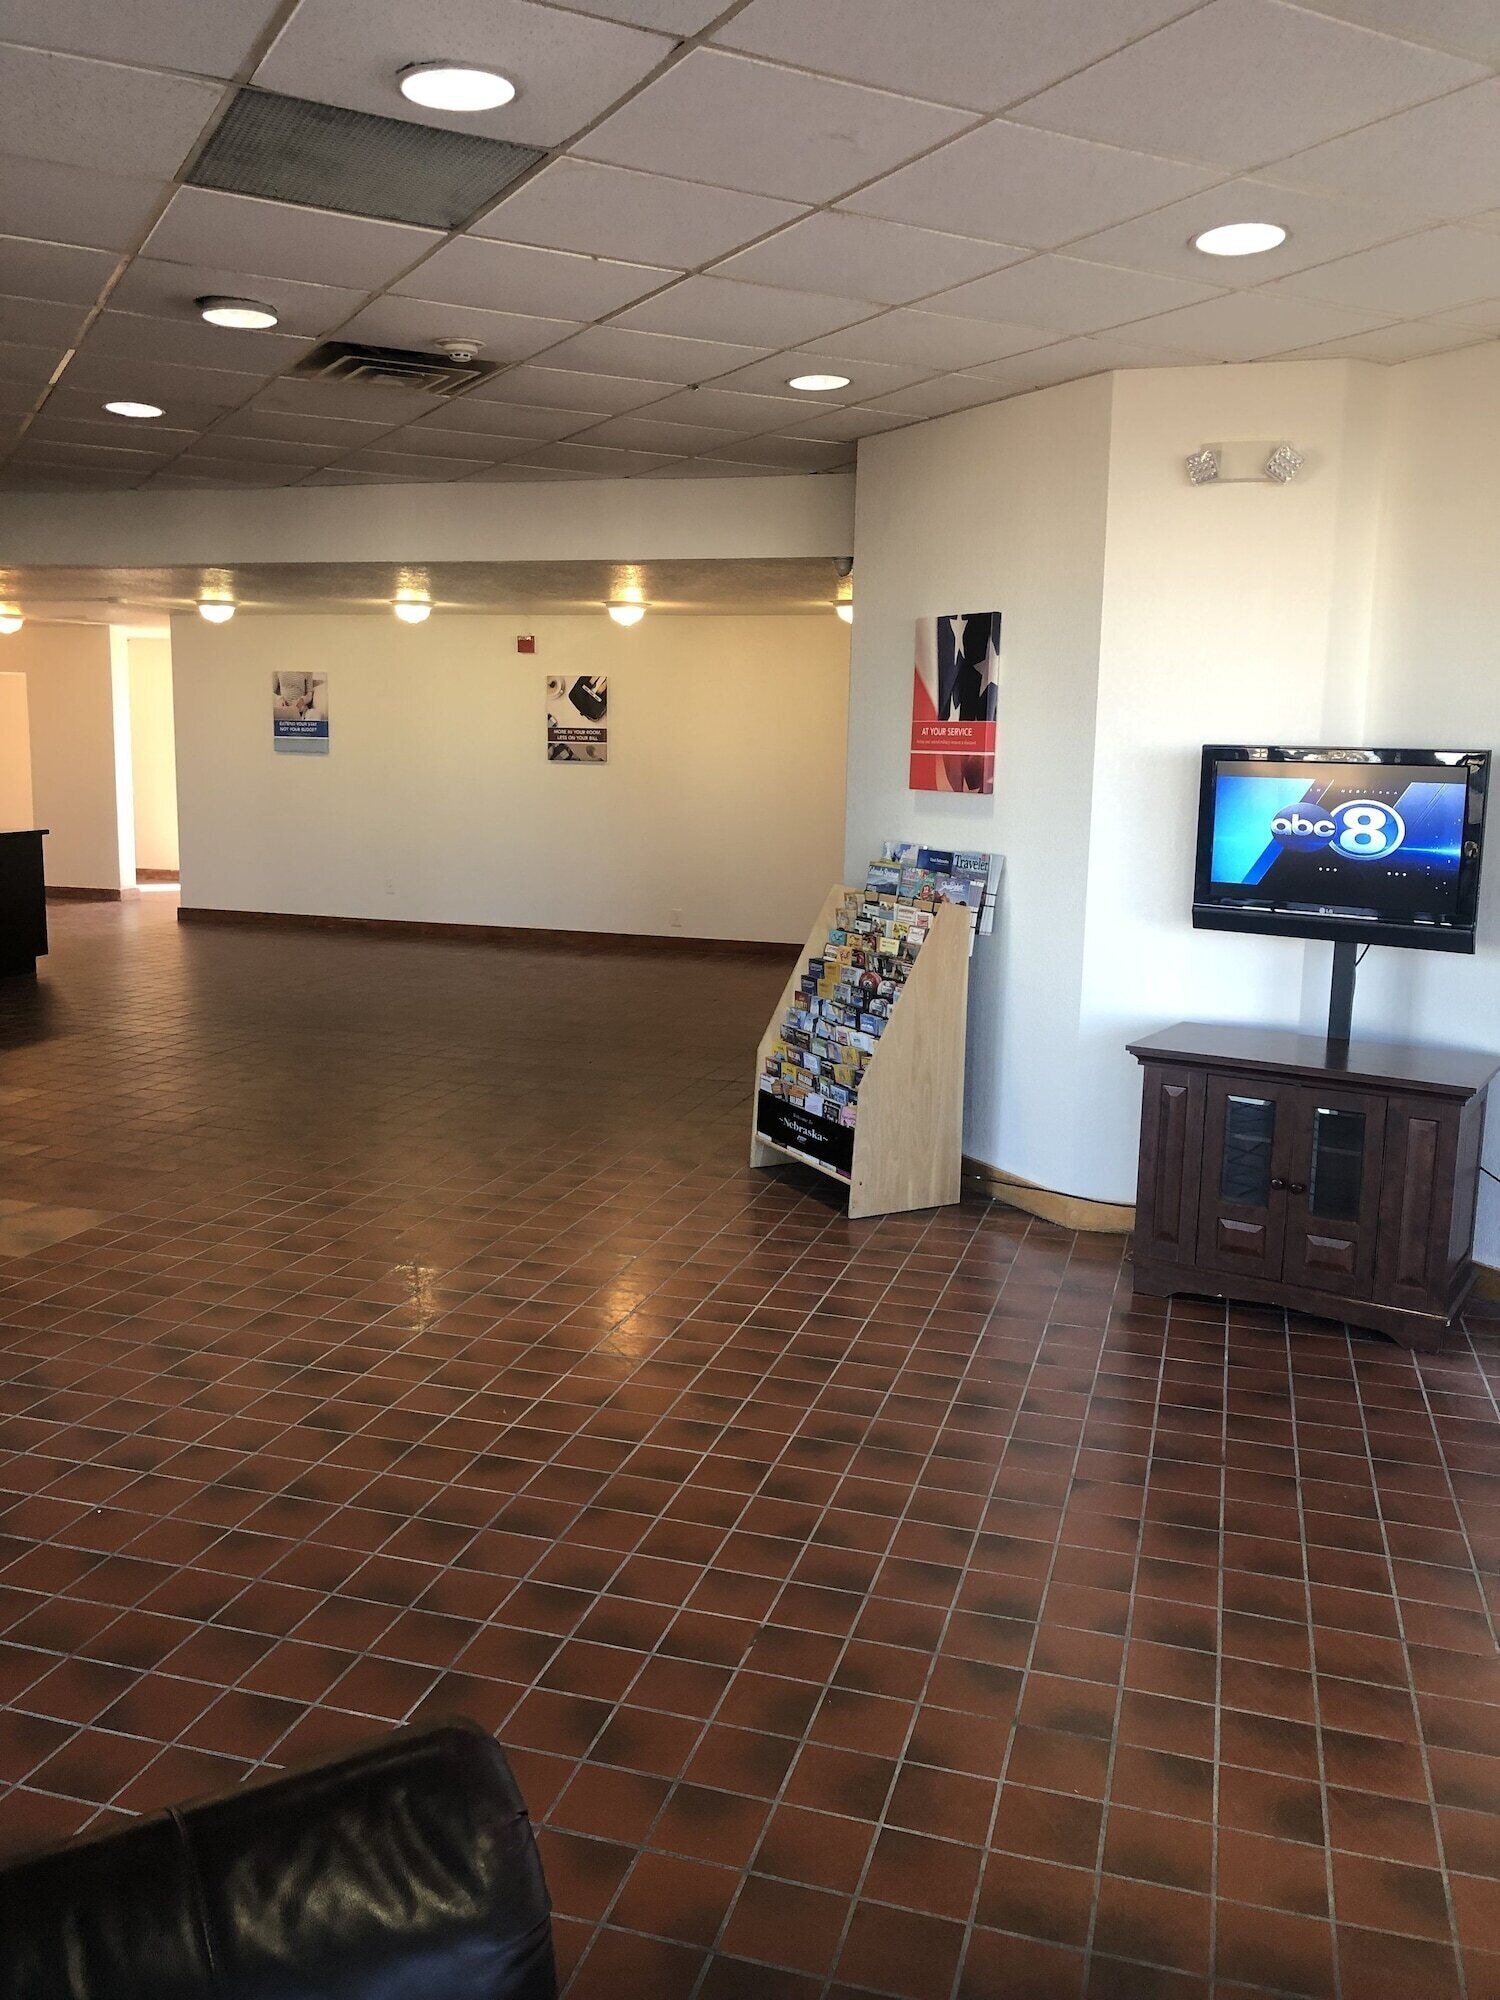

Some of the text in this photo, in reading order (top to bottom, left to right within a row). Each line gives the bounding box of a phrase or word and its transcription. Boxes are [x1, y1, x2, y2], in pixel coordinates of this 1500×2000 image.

[921, 727, 972, 736] AT YOUR SERVICE
[1270, 807, 1387, 854] abc 8
[954, 854, 988, 871] Traveler
[783, 1117, 823, 1141] Nebraska
